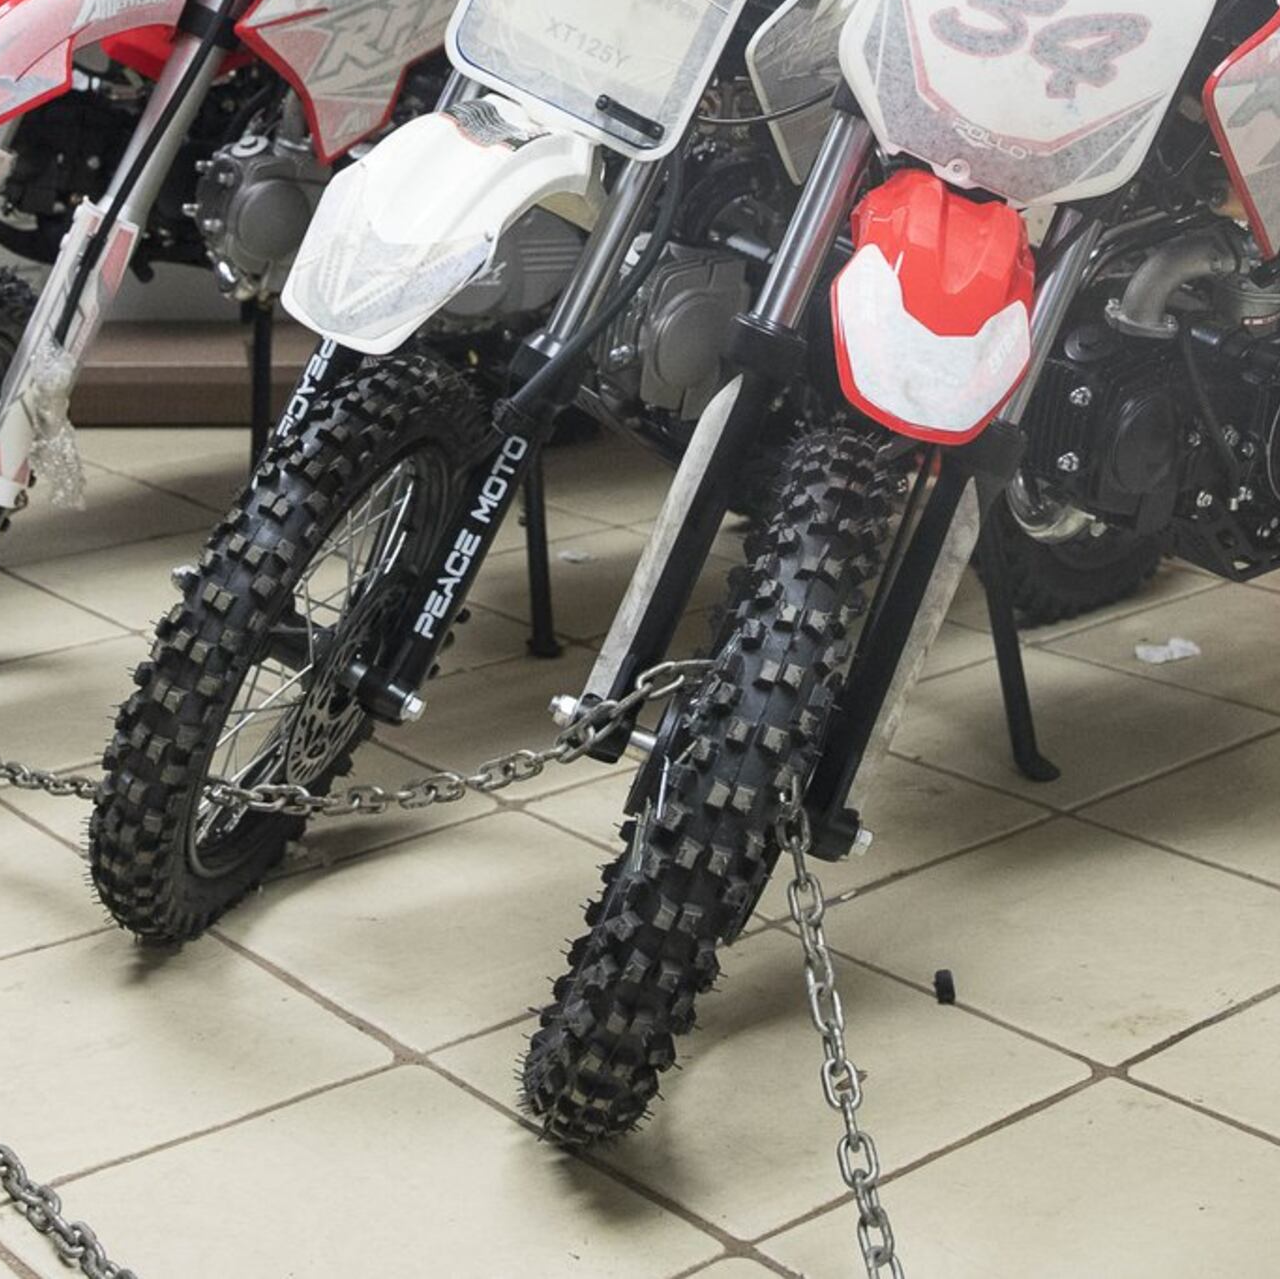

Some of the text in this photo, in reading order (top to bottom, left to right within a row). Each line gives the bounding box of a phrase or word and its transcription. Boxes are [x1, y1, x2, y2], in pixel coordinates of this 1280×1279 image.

[545, 17, 633, 70] XT125Y
[413, 435, 528, 639] PEACE MOTO
